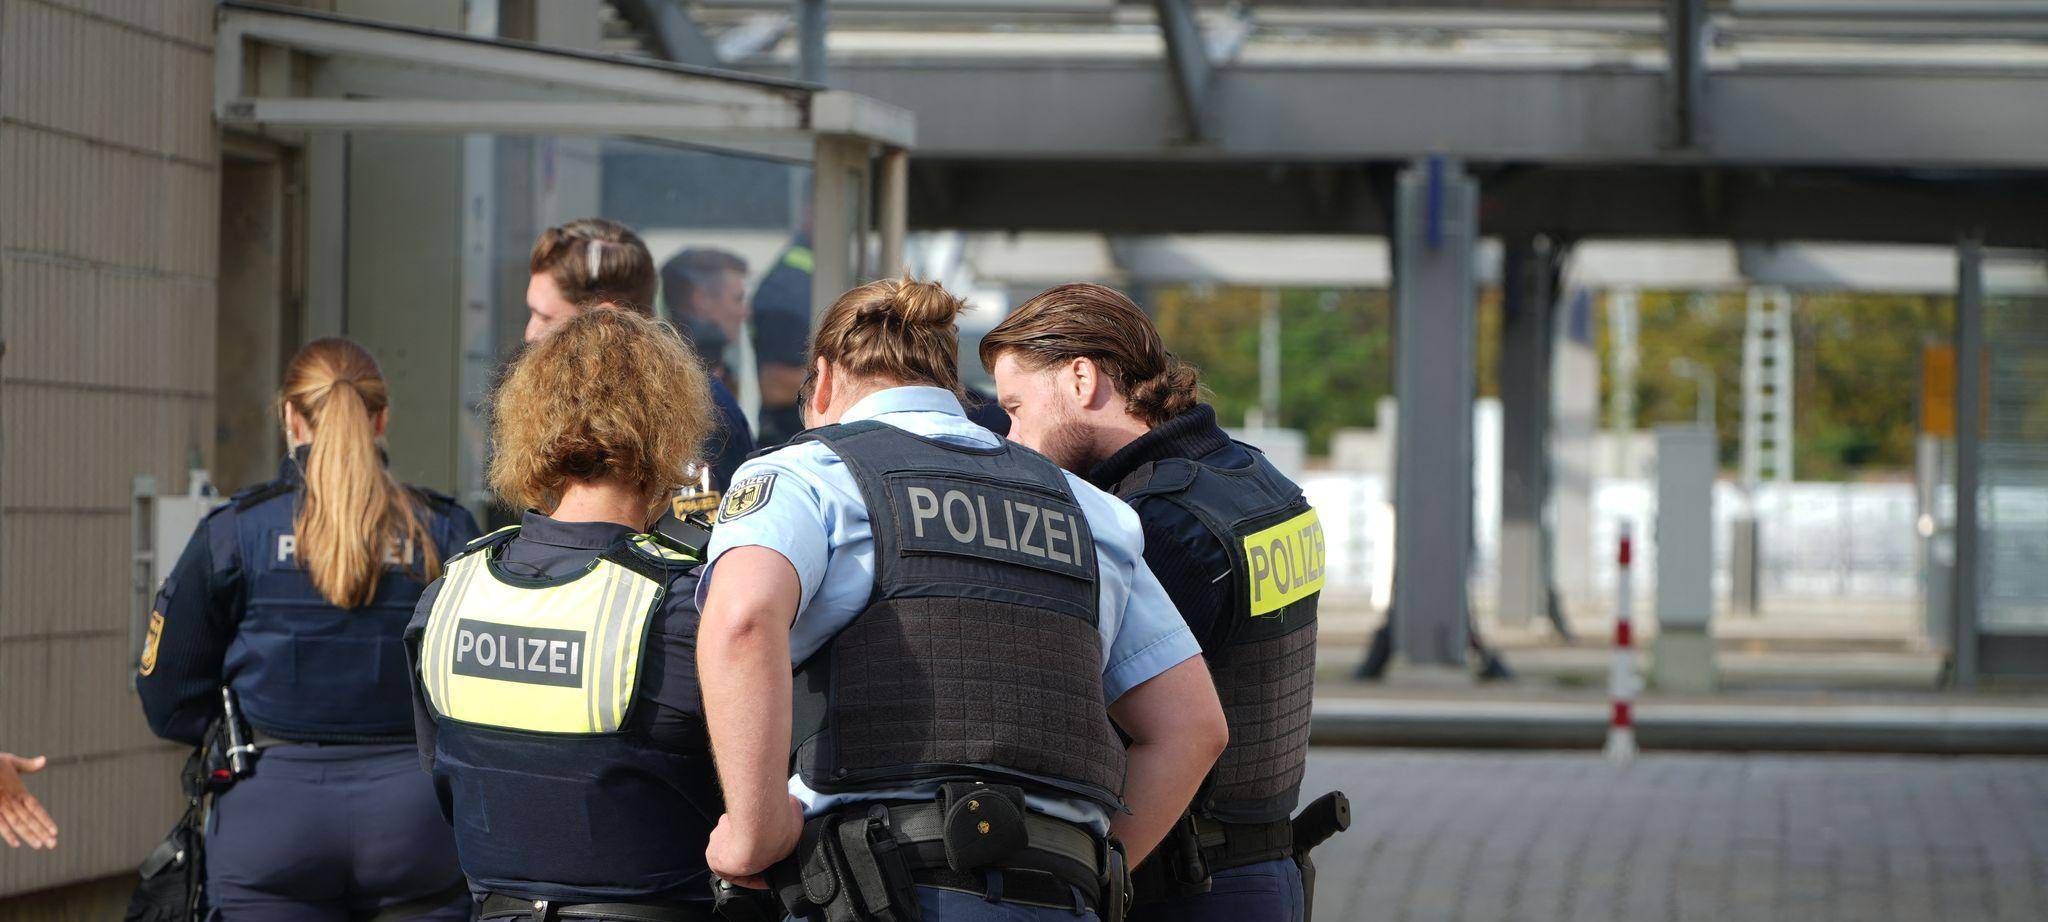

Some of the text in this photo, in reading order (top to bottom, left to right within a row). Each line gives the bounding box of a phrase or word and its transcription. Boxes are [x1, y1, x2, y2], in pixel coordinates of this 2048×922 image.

[727, 476, 769, 496] POLIZEI
[907, 487, 1082, 566] POLIZEI
[1250, 519, 1326, 602] POLIZE
[456, 629, 579, 675] POLIZEI
